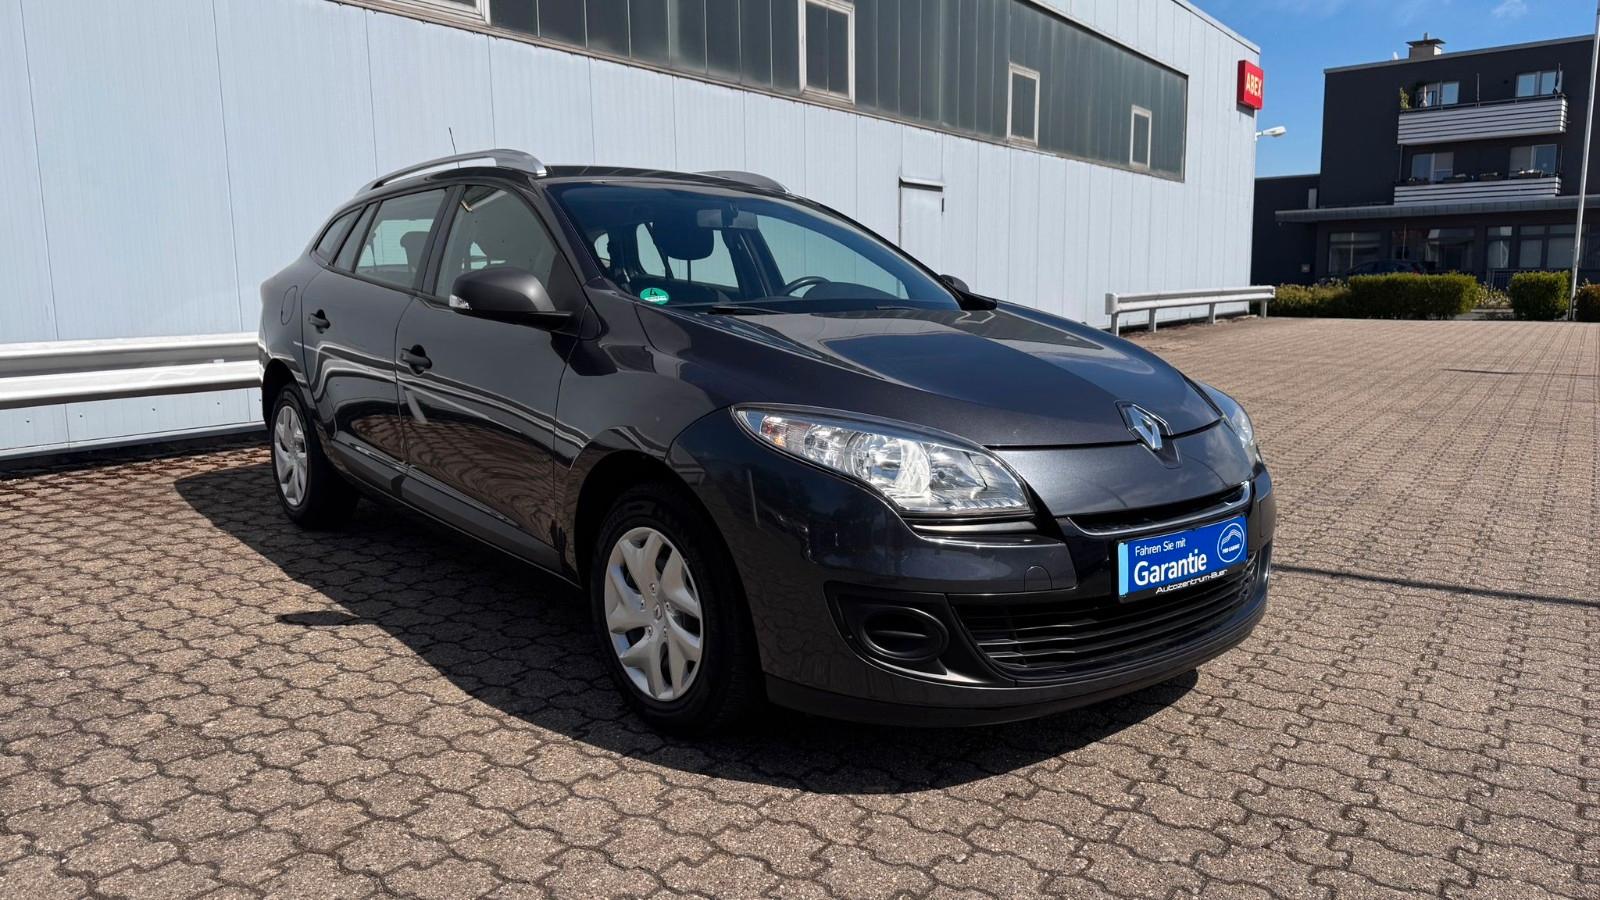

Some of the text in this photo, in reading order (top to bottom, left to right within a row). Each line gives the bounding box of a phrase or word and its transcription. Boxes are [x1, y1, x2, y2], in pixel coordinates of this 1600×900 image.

[1246, 72, 1262, 98] ABEX
[650, 288, 657, 296] 4
[1135, 537, 1187, 556] Fahren Sie mit
[1134, 549, 1207, 586] Garantie
